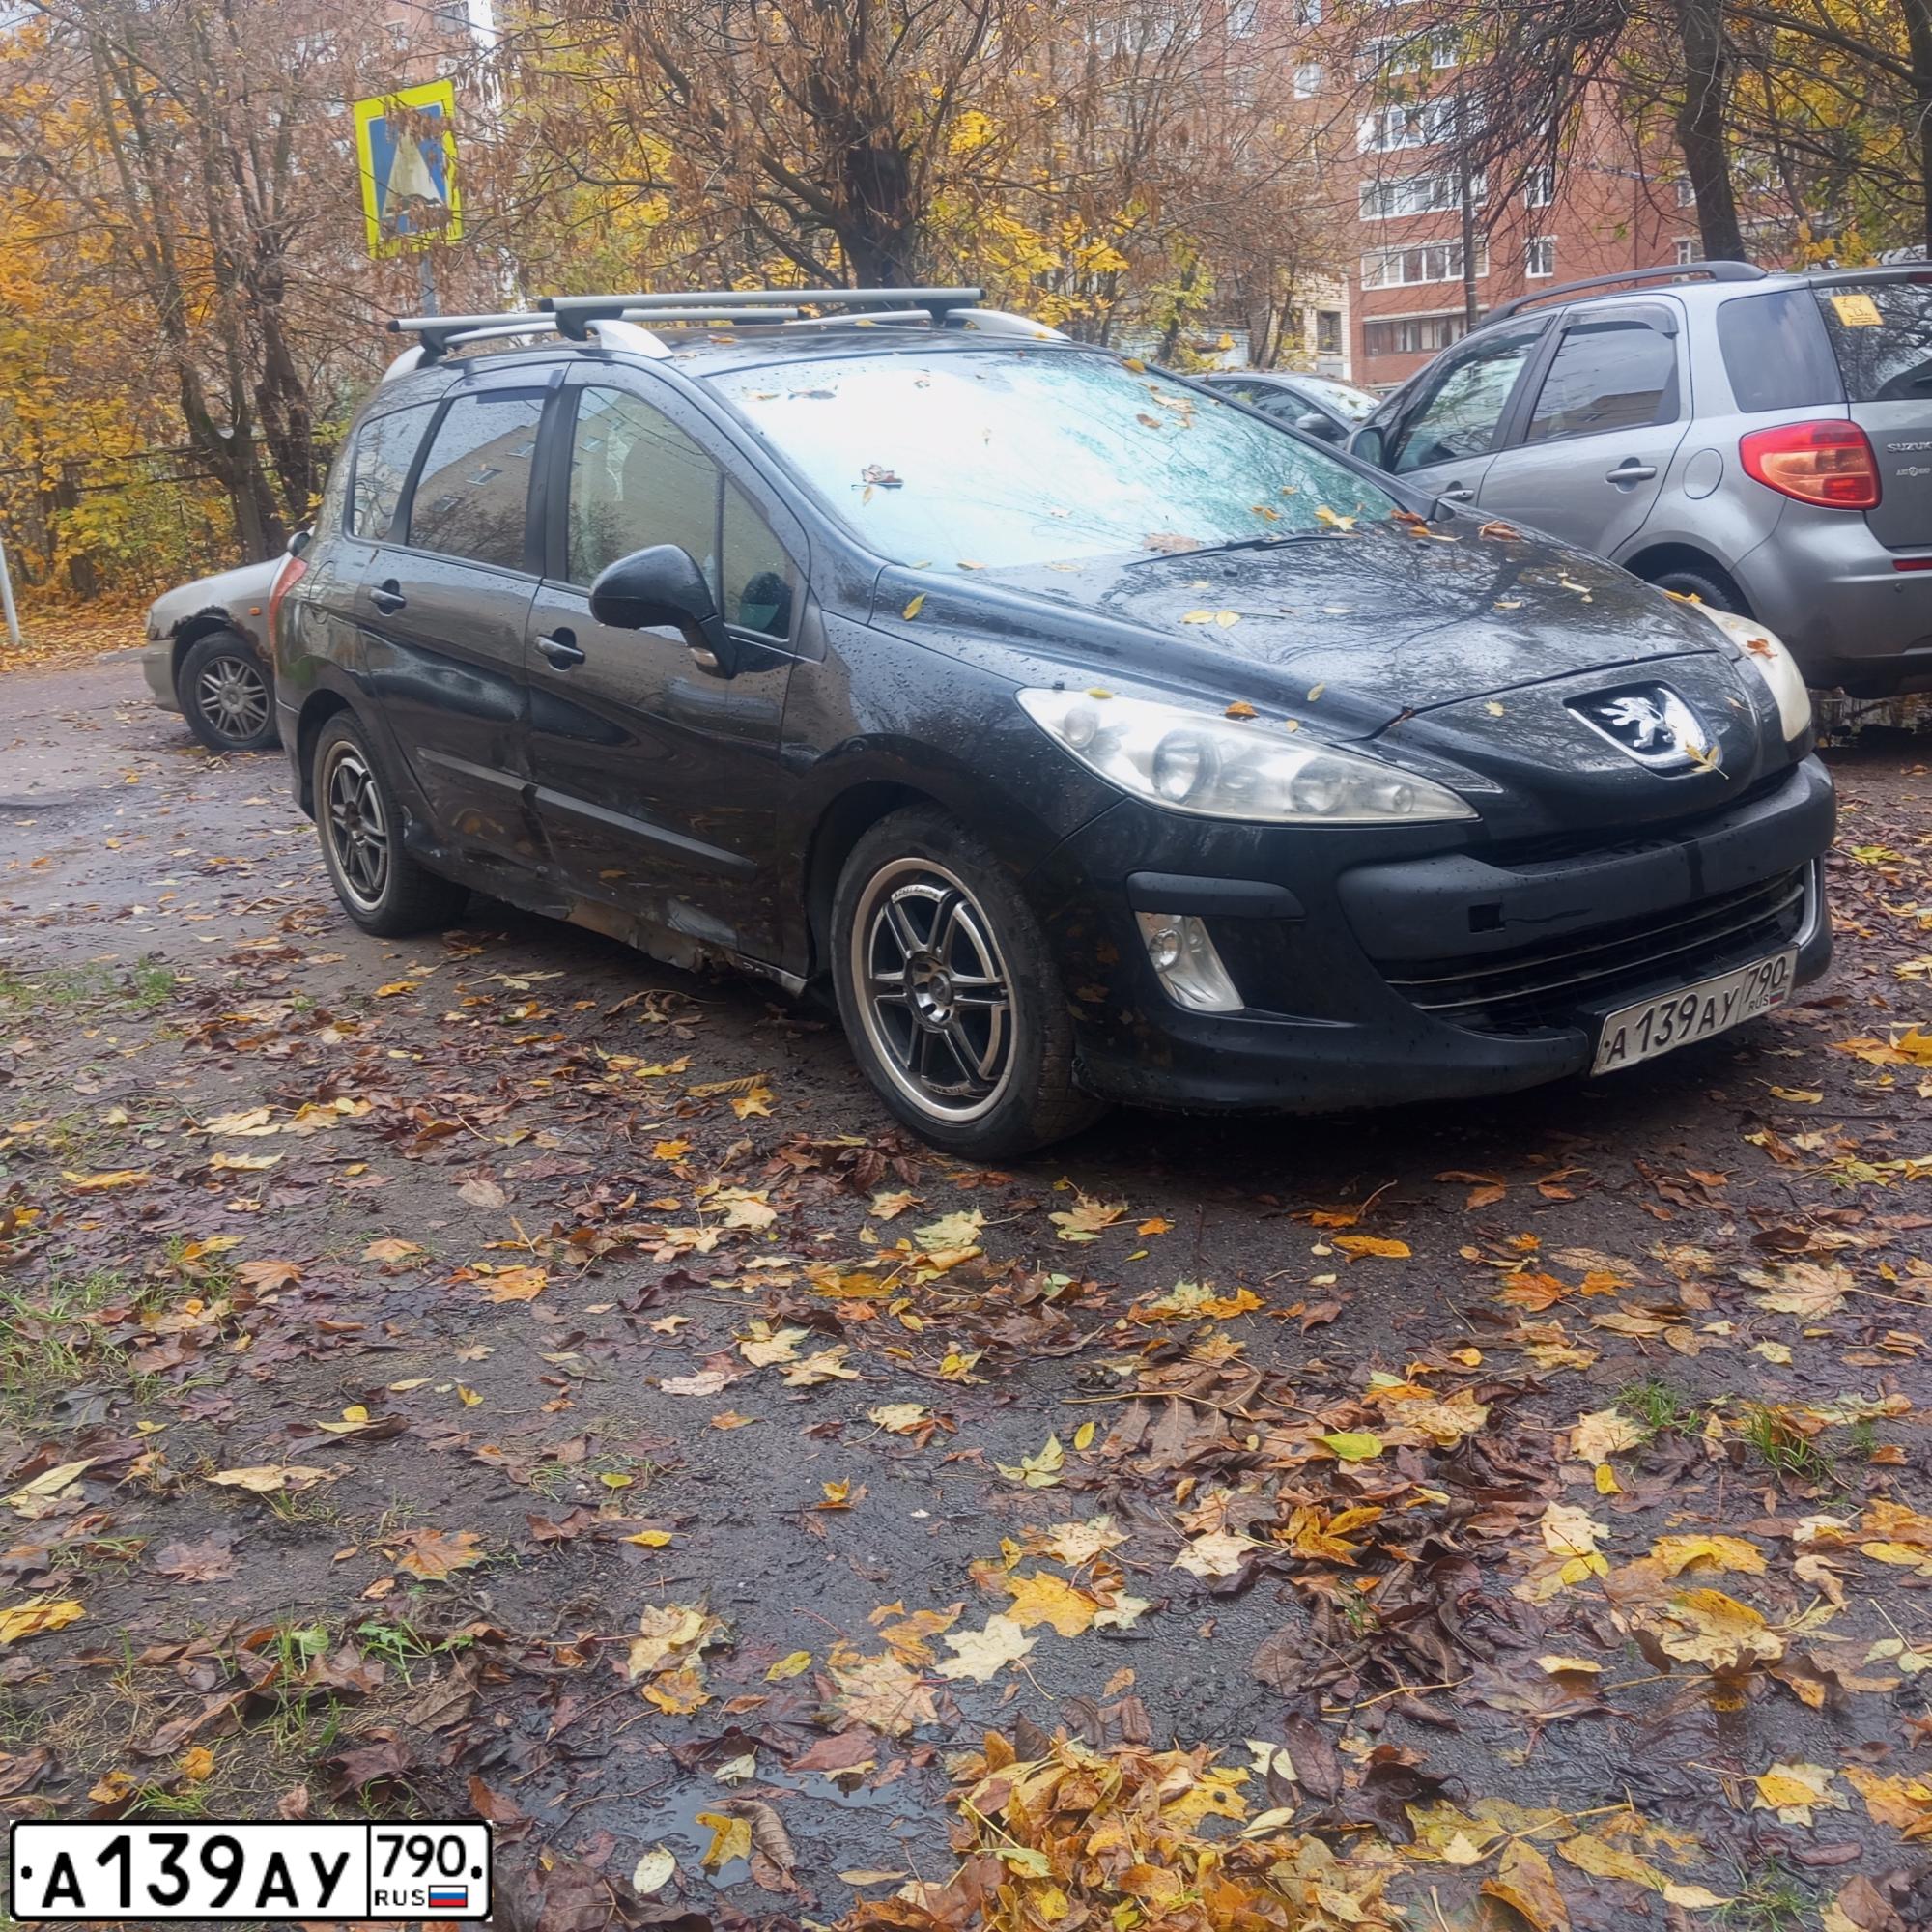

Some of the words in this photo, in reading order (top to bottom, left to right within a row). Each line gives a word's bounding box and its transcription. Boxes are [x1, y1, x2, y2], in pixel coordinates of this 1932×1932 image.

[1606, 986, 1740, 1064] А139АУ
[1744, 956, 1786, 1003] 790
[1747, 993, 1770, 1012] RUS
